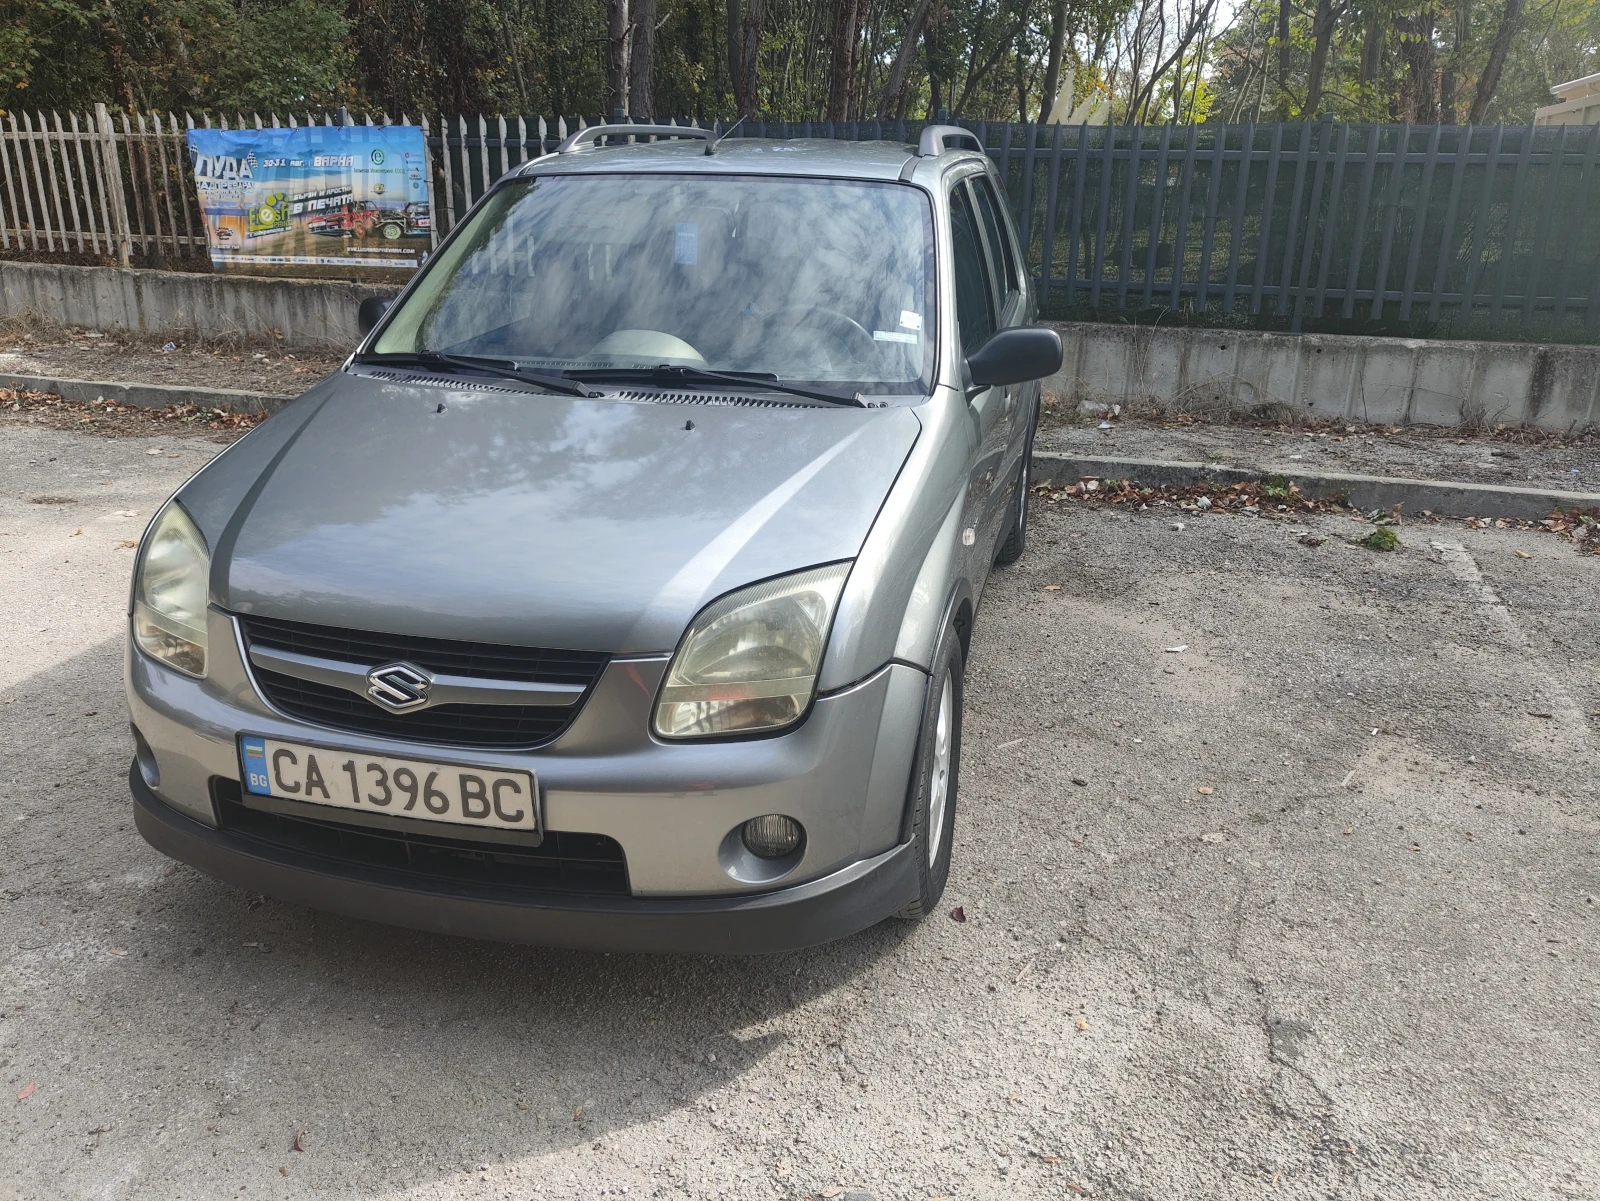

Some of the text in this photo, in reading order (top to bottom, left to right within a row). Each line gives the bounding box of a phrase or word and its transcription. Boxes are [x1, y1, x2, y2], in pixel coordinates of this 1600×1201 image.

[194, 154, 253, 180] ЛУДА
[313, 155, 354, 167] ВАРНА
[293, 191, 317, 201] БЪРЗИ
[326, 185, 352, 196] ЯРОСТНИ
[293, 193, 354, 214] В ПЕЧАТА
[250, 772, 268, 787] BG
[272, 749, 524, 823] CA 1396 BC
